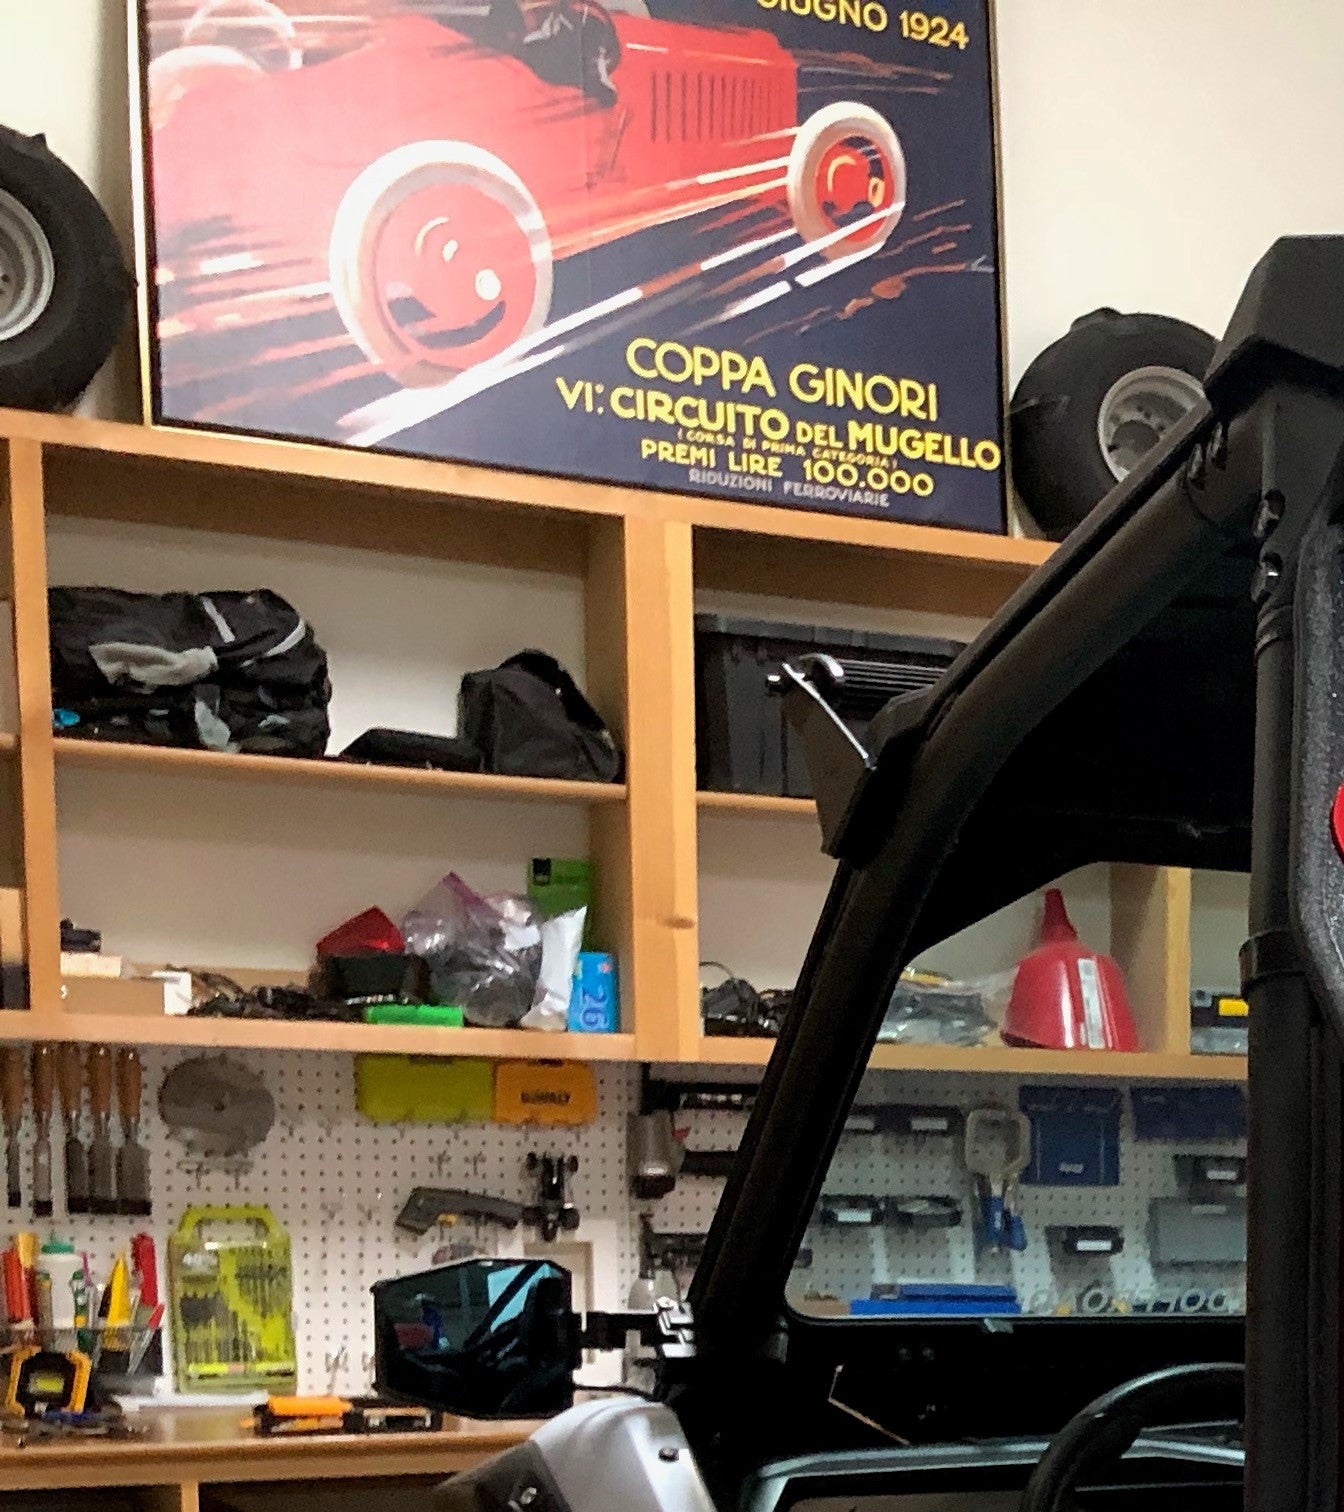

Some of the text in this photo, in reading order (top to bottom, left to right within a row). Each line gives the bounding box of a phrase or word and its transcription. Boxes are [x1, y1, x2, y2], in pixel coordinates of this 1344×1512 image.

[899, 9, 970, 50] 1924
[626, 337, 938, 422] COPPA GINORI
[609, 386, 790, 441] CIRCUITO
[795, 421, 843, 449] DEL
[847, 419, 1001, 471] MUGELLO
[641, 439, 935, 497] PREMI LIRE 100.000
[688, 468, 890, 508] RIDUZIONI FERROVIARIE
